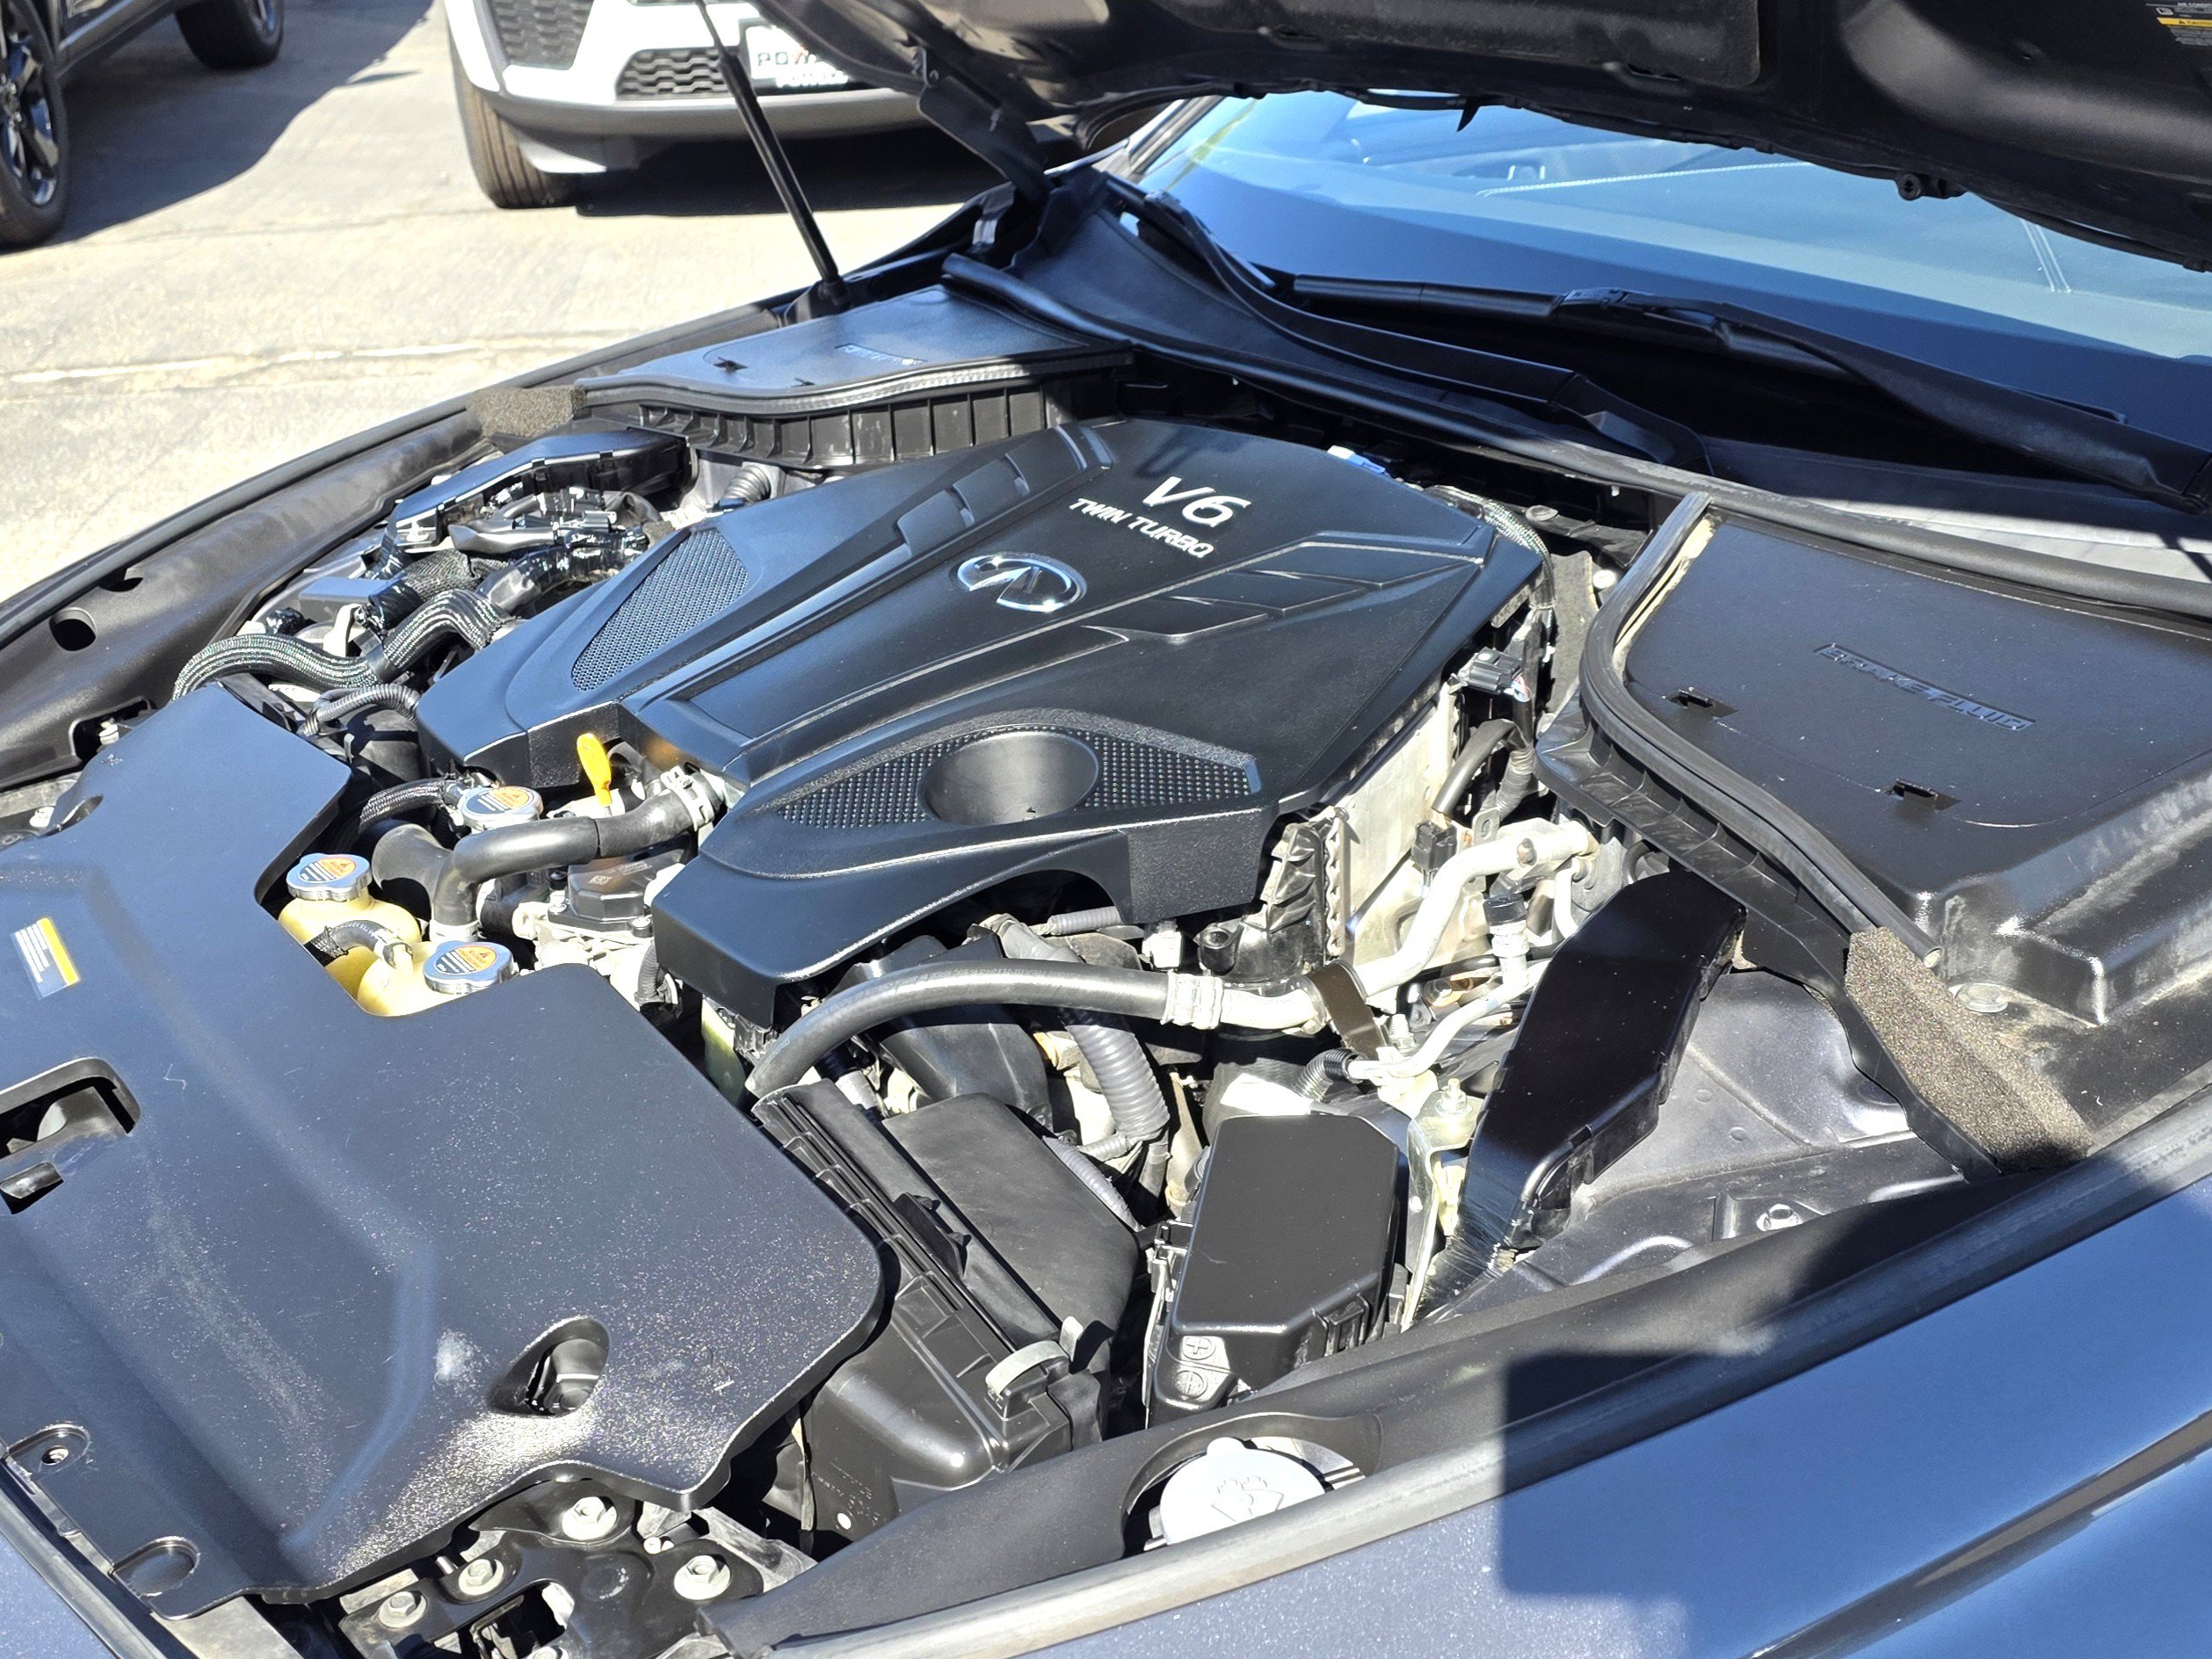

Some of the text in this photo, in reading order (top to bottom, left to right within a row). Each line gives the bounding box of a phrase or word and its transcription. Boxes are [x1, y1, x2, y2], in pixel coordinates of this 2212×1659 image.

[1069, 497, 1215, 558] TWIN TURBO
[1142, 475, 1251, 527] V6
[1819, 648, 2027, 730] BRAKE FLUID
